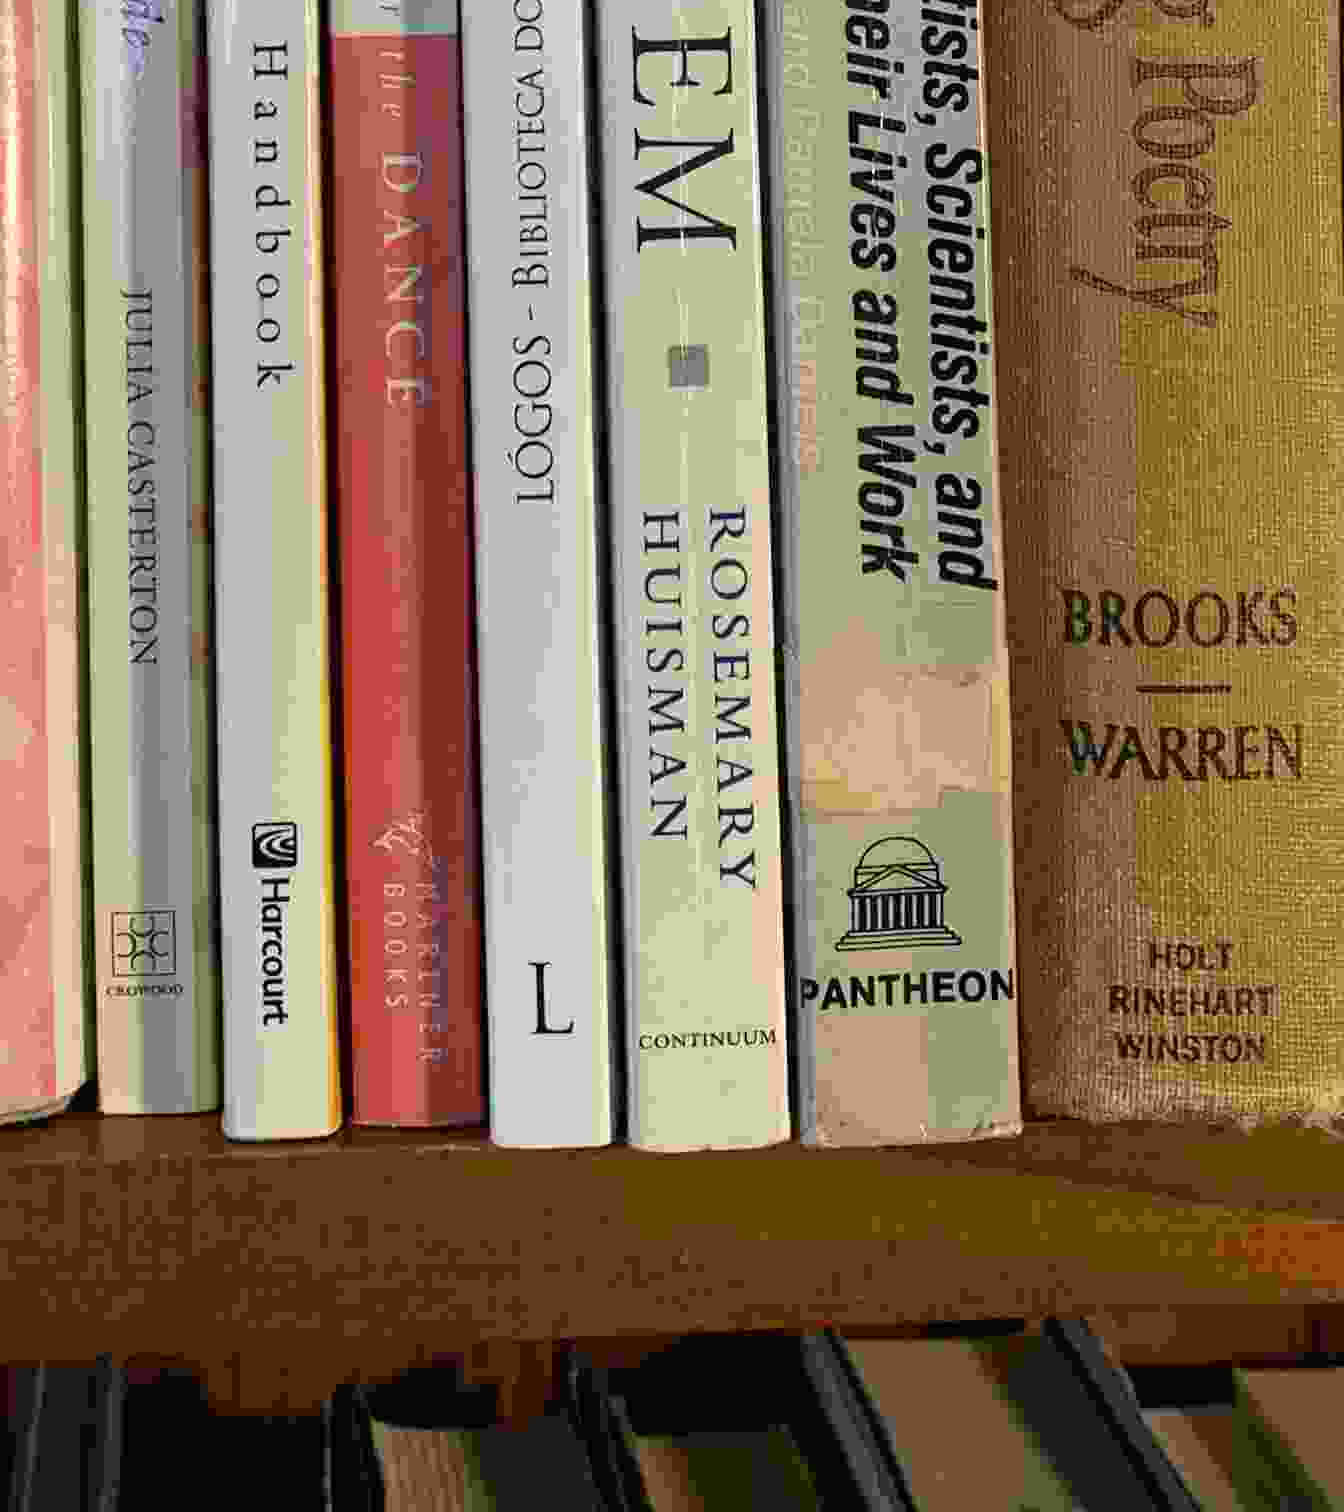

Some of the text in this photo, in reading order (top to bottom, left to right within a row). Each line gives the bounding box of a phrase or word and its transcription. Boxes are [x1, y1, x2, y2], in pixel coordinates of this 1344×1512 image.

[378, 50, 416, 120] the
[252, 41, 294, 389] Handbook
[513, 68, 549, 289] BIBLIOTECA
[848, 110, 907, 269] Lives
[1070, 56, 1258, 326] Poetry
[381, 151, 426, 408] DANCE
[922, 143, 990, 456] Scientists,
[852, 290, 914, 406] and
[121, 288, 159, 665] JULIA CASTERTON
[858, 425, 919, 583] Work
[935, 473, 998, 590] and
[643, 511, 687, 840] HUISMAN
[1064, 590, 1297, 647] BROOKS
[709, 506, 756, 890] ROSEMARY
[1062, 720, 1303, 781] WARREN
[261, 878, 290, 1026] Harcourt
[384, 883, 409, 1009] BOOKS
[528, 961, 575, 1035] L
[801, 969, 1016, 1010] PANTHEON
[1109, 985, 1272, 1016] RINEHART
[1150, 941, 1232, 970] HOLT
[639, 1029, 776, 1049] CONTINUUM
[1118, 1034, 1264, 1062] WINSTON
